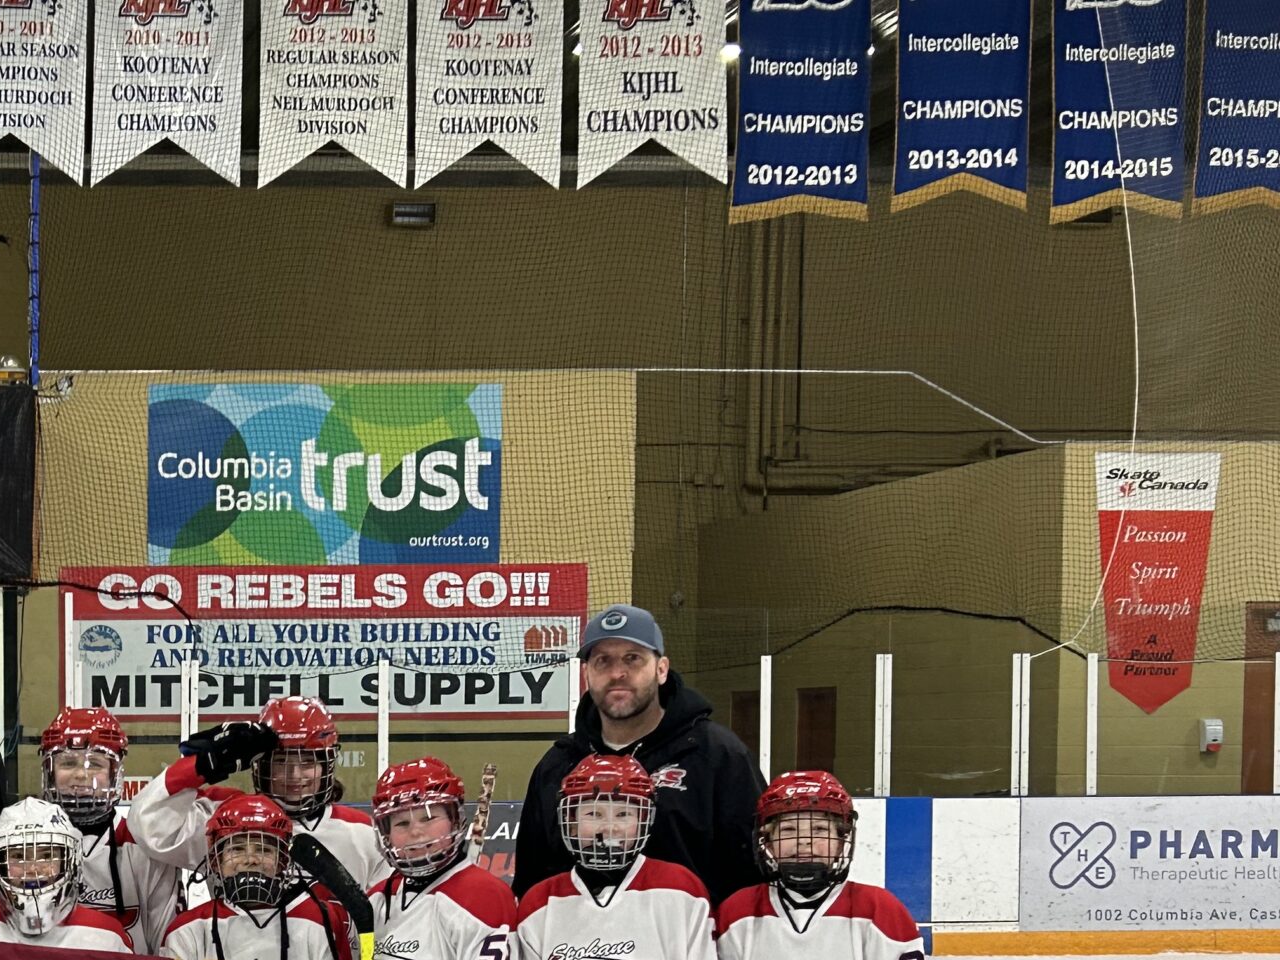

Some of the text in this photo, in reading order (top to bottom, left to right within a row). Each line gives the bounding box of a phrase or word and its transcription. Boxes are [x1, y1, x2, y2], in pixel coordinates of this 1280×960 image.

[21, 43, 79, 59] SEASON
[599, 34, 703, 58] 2012 2013
[908, 33, 1019, 55] Intercollegiate
[1065, 43, 1176, 64] Intercollegiate
[122, 55, 211, 75] KOOTENAY
[267, 49, 400, 65] REGULAR SEASON
[444, 58, 534, 77] KOOTENAY
[750, 57, 858, 80] Intercollegiate
[286, 73, 379, 89] CHAMPIONS
[622, 71, 684, 100] KIJHL
[111, 84, 223, 104] CONFERENCE
[272, 96, 394, 112] NEIL MURDOCH
[434, 87, 545, 105] CONFERENCE
[903, 98, 1023, 120] CHAMPIONS
[1058, 108, 1178, 130] CHAMPIONS
[117, 113, 216, 132] CHAMPIONS
[297, 119, 367, 134] DIVISION
[439, 116, 538, 134] CHAMPIONS
[587, 107, 719, 133] CHAMPIONS
[744, 112, 864, 134] CHAMPIONS
[908, 148, 1018, 170] 2013-2014
[1209, 147, 1280, 168] 2015-2
[747, 164, 858, 186] 2012-2013
[1065, 157, 1174, 180] 2014-2015
[157, 436, 492, 512] Columbia trust
[1106, 468, 1160, 483] Skate
[1138, 478, 1209, 491] Canada
[215, 484, 292, 513] Basin
[409, 534, 490, 551] ourtrust.org
[1123, 525, 1187, 543] Passion
[1130, 561, 1179, 584] Spirit
[97, 571, 551, 610] GO REBELS GO!!!
[1115, 597, 1191, 621] Triumph
[146, 621, 501, 645] FOR ALL YOUR BUILDING
[150, 646, 496, 668] AND RENOVATION NEEDS
[361, 672, 553, 706] SUPPLY
[1130, 867, 1228, 883] Therapeutic
[1086, 908, 1243, 922] 1002 Columbia Ave,
